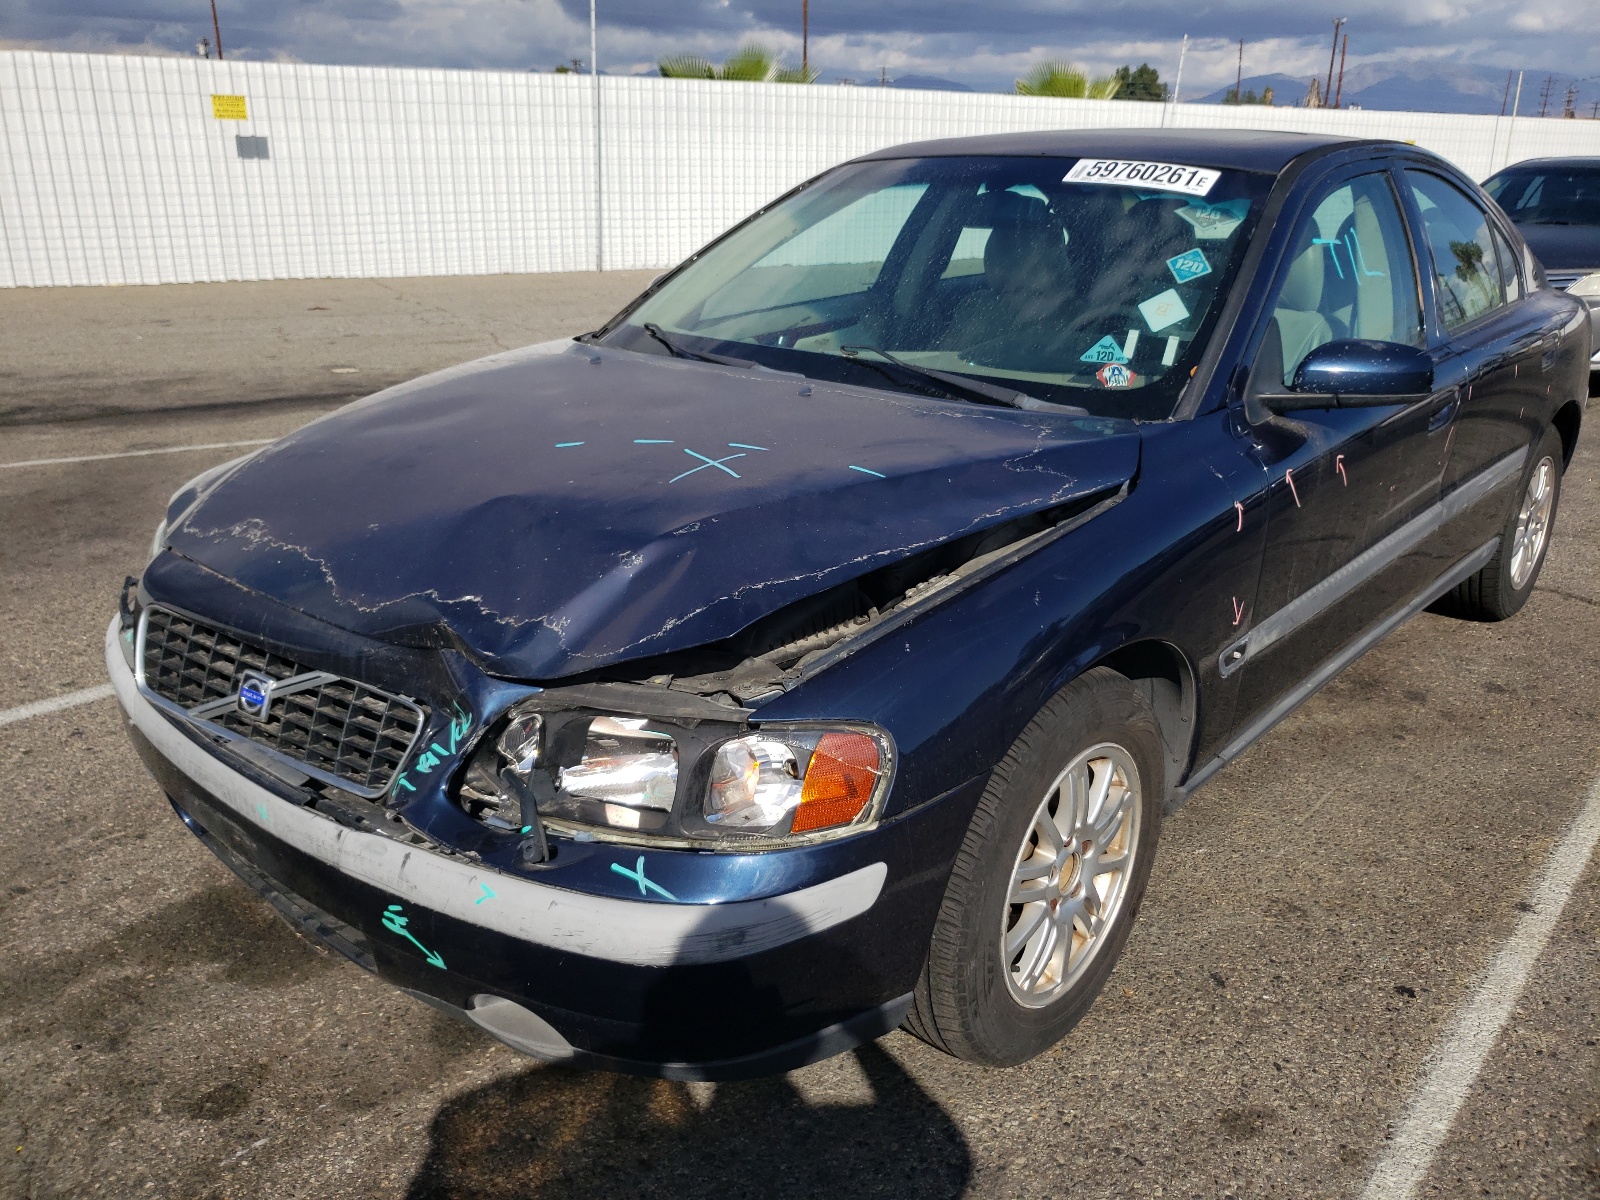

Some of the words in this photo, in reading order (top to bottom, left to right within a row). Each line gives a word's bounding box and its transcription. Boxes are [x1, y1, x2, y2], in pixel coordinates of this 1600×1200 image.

[1086, 161, 1199, 187] 59760261
[1196, 177, 1209, 188] E
[1175, 258, 1204, 273] 12D
[1095, 350, 1115, 362] 12D
